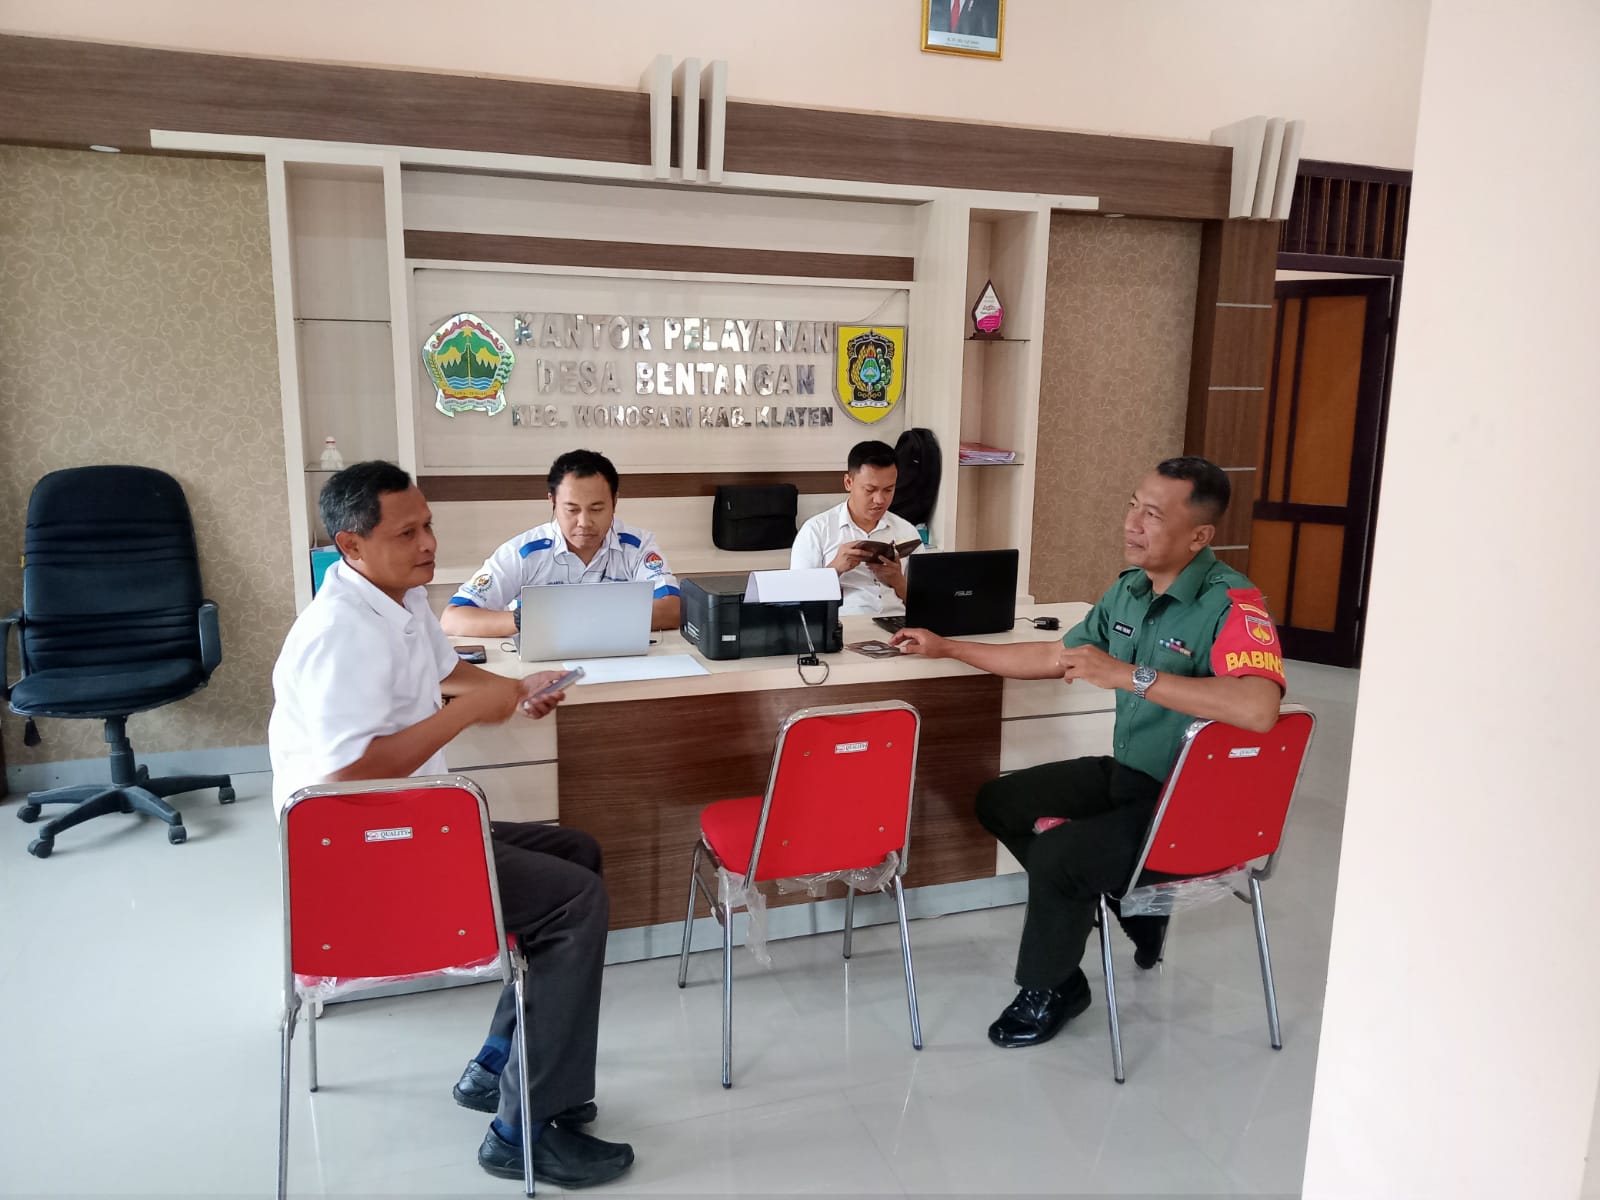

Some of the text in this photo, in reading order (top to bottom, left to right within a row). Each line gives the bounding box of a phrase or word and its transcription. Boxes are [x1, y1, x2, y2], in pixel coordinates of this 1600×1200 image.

[513, 312, 834, 353] KANTOR PELAYANAN
[536, 359, 815, 396] DESA BENTANGAN
[512, 404, 833, 428] KEC. WONOSARI KAB. KLATEN
